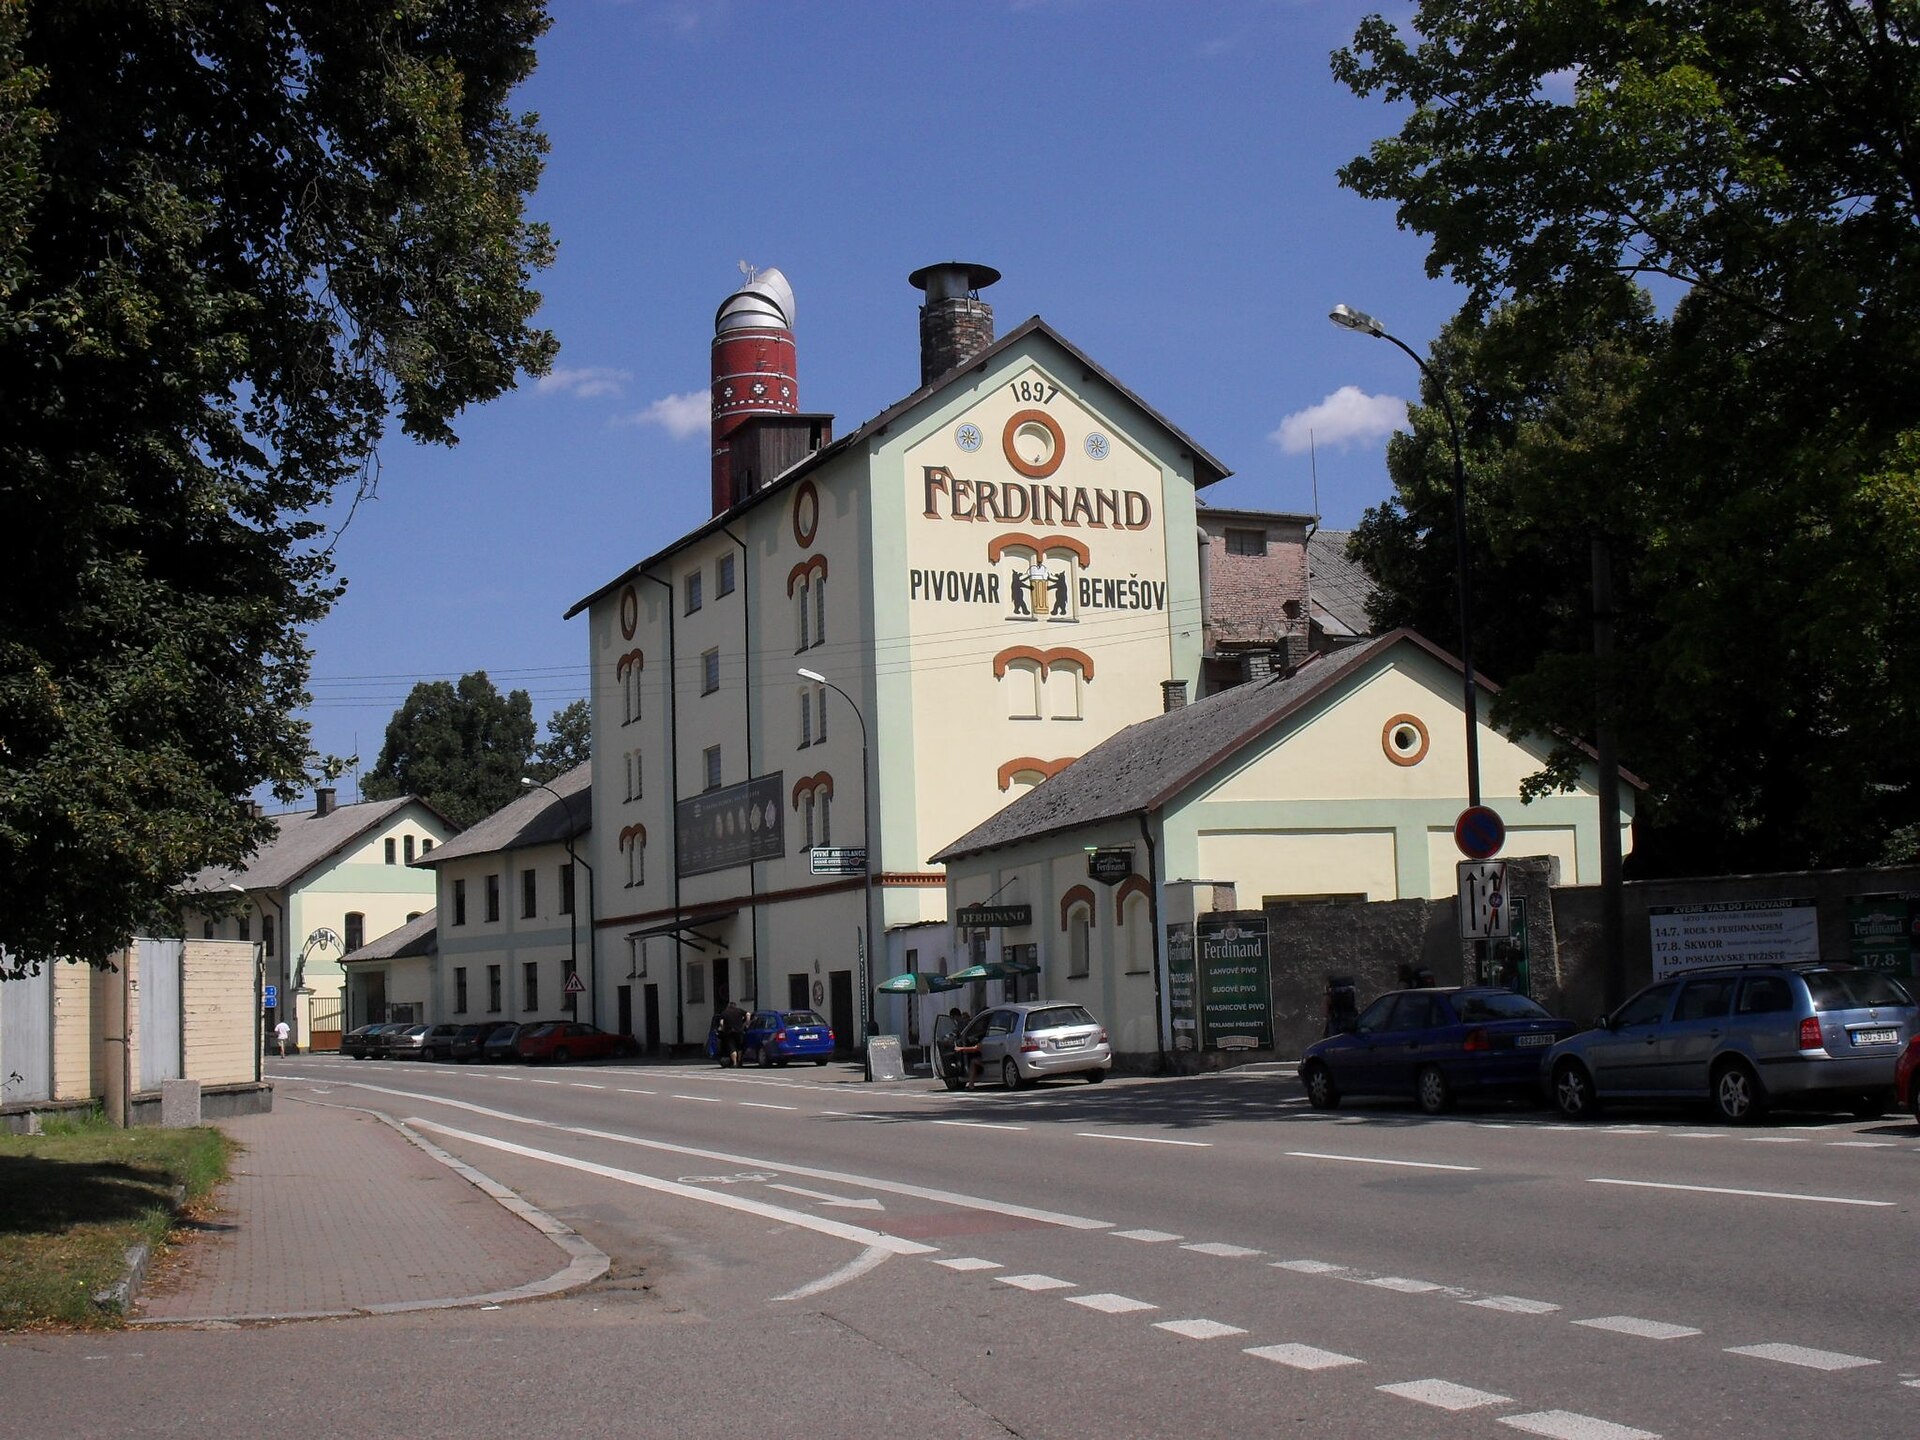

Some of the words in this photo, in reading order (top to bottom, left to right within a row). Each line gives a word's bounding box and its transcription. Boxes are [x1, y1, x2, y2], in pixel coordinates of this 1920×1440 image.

[1010, 381, 1060, 405] 1897
[921, 465, 1152, 531] FERDINAND
[910, 569, 1000, 604] PIVOVAR
[1079, 573, 1166, 611] BENEŠOV
[1096, 862, 1126, 872] Ferdinand
[1673, 905, 1705, 914] ZVEME
[1728, 903, 1743, 911] DO
[962, 911, 1025, 923] FERDINAND
[1655, 927, 1680, 937] 14.7.
[1683, 926, 1708, 935] ROCK
[1709, 926, 1715, 934] S
[1717, 923, 1783, 934] FERDINANDEM
[1853, 920, 1903, 936] Ferdinand
[1204, 939, 1262, 959] Ferdinand
[1655, 942, 1681, 952] 17.8.
[1684, 939, 1723, 950] ŠKWOR
[1663, 955, 1682, 966] 1.9.
[1861, 952, 1901, 967] 17.8.
[1210, 967, 1239, 975] LAHVOVÉ
[1241, 966, 1257, 974] PIVO
[1212, 985, 1238, 993] SUDOVÉ
[1206, 1003, 1247, 1012] KVASNICOVÉ
[1249, 1003, 1265, 1011] PIVO
